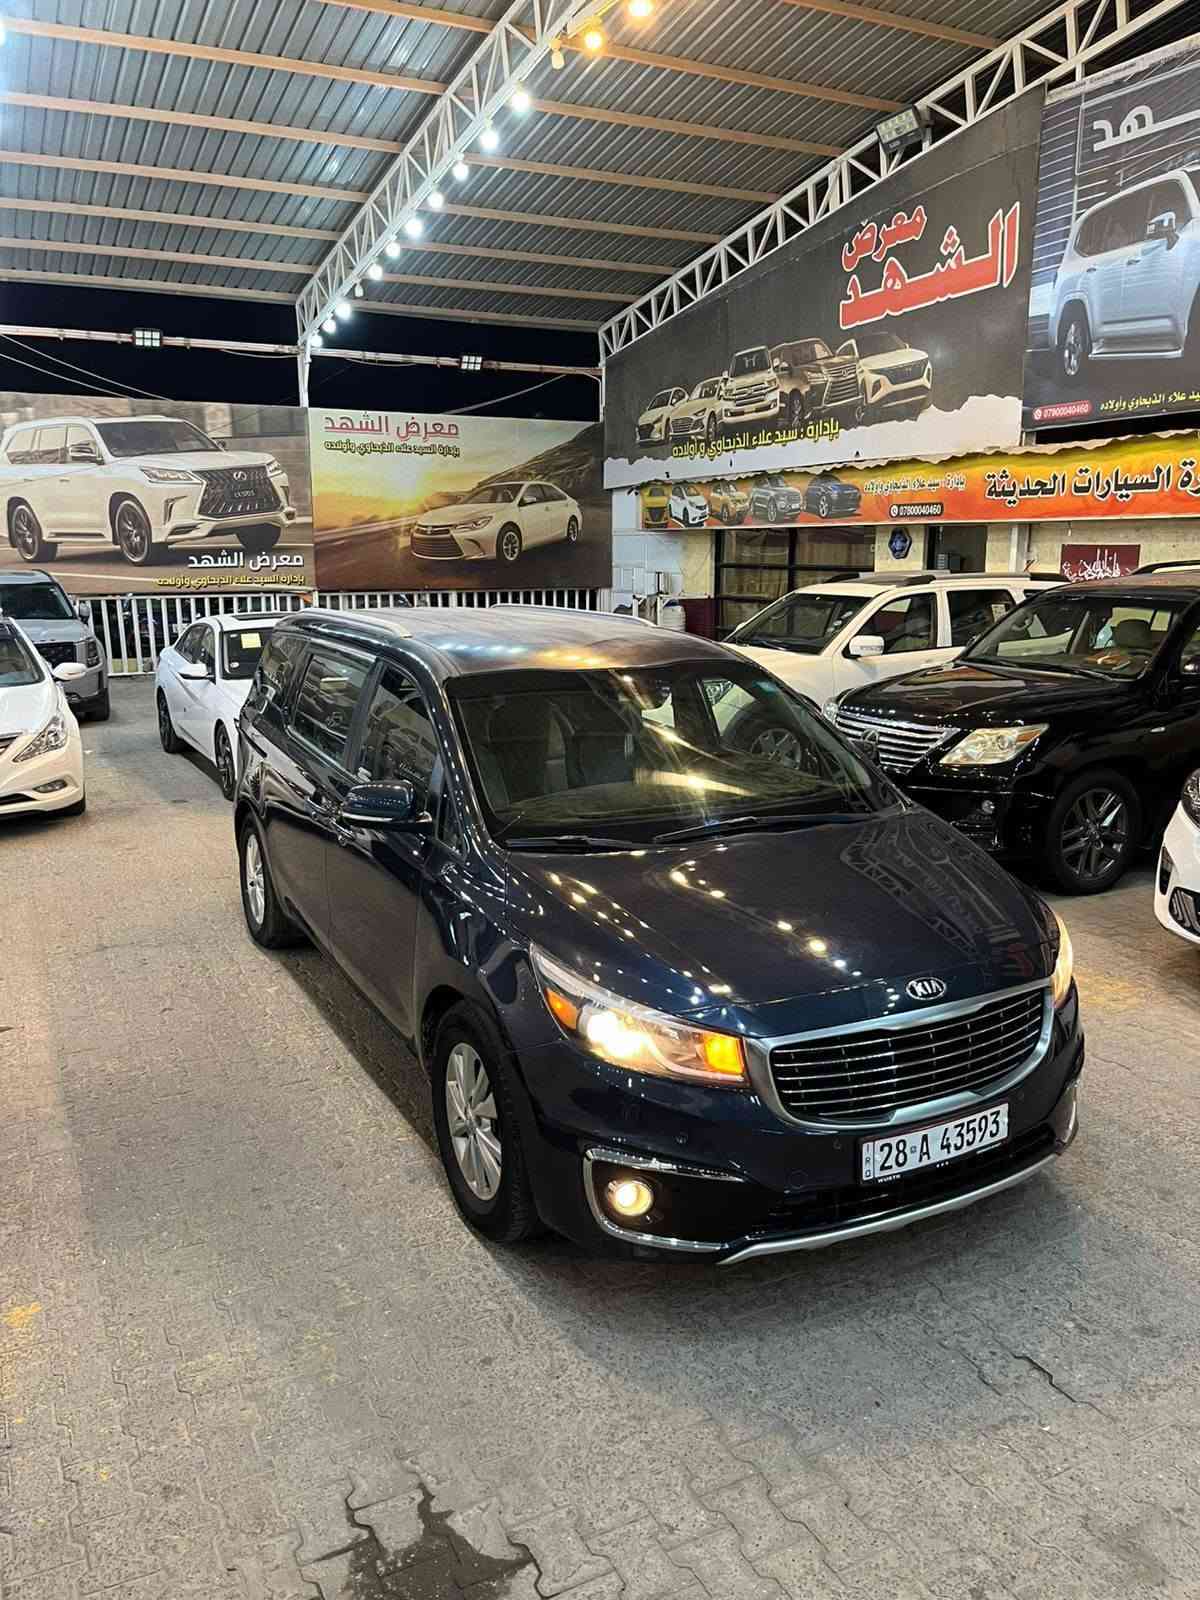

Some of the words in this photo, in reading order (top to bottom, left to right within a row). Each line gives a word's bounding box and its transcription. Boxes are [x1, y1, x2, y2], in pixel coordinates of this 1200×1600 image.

[1093, 104, 1200, 152] هد
[842, 205, 927, 272] معرض
[840, 201, 1020, 329] الشهد
[324, 411, 389, 433] الشهد
[396, 416, 459, 440] معرض
[806, 417, 839, 442] بإدارة
[751, 428, 772, 447] علاء
[774, 428, 798, 446] سيد
[987, 470, 1065, 506] الحديثة
[1073, 465, 1171, 500] السيارات
[187, 549, 244, 568] الشهد
[249, 551, 304, 571] معرض
[914, 980, 942, 997] KIA
[879, 1139, 908, 1171] 28
[918, 1132, 931, 1163] A
[940, 1109, 1001, 1154] 43593
